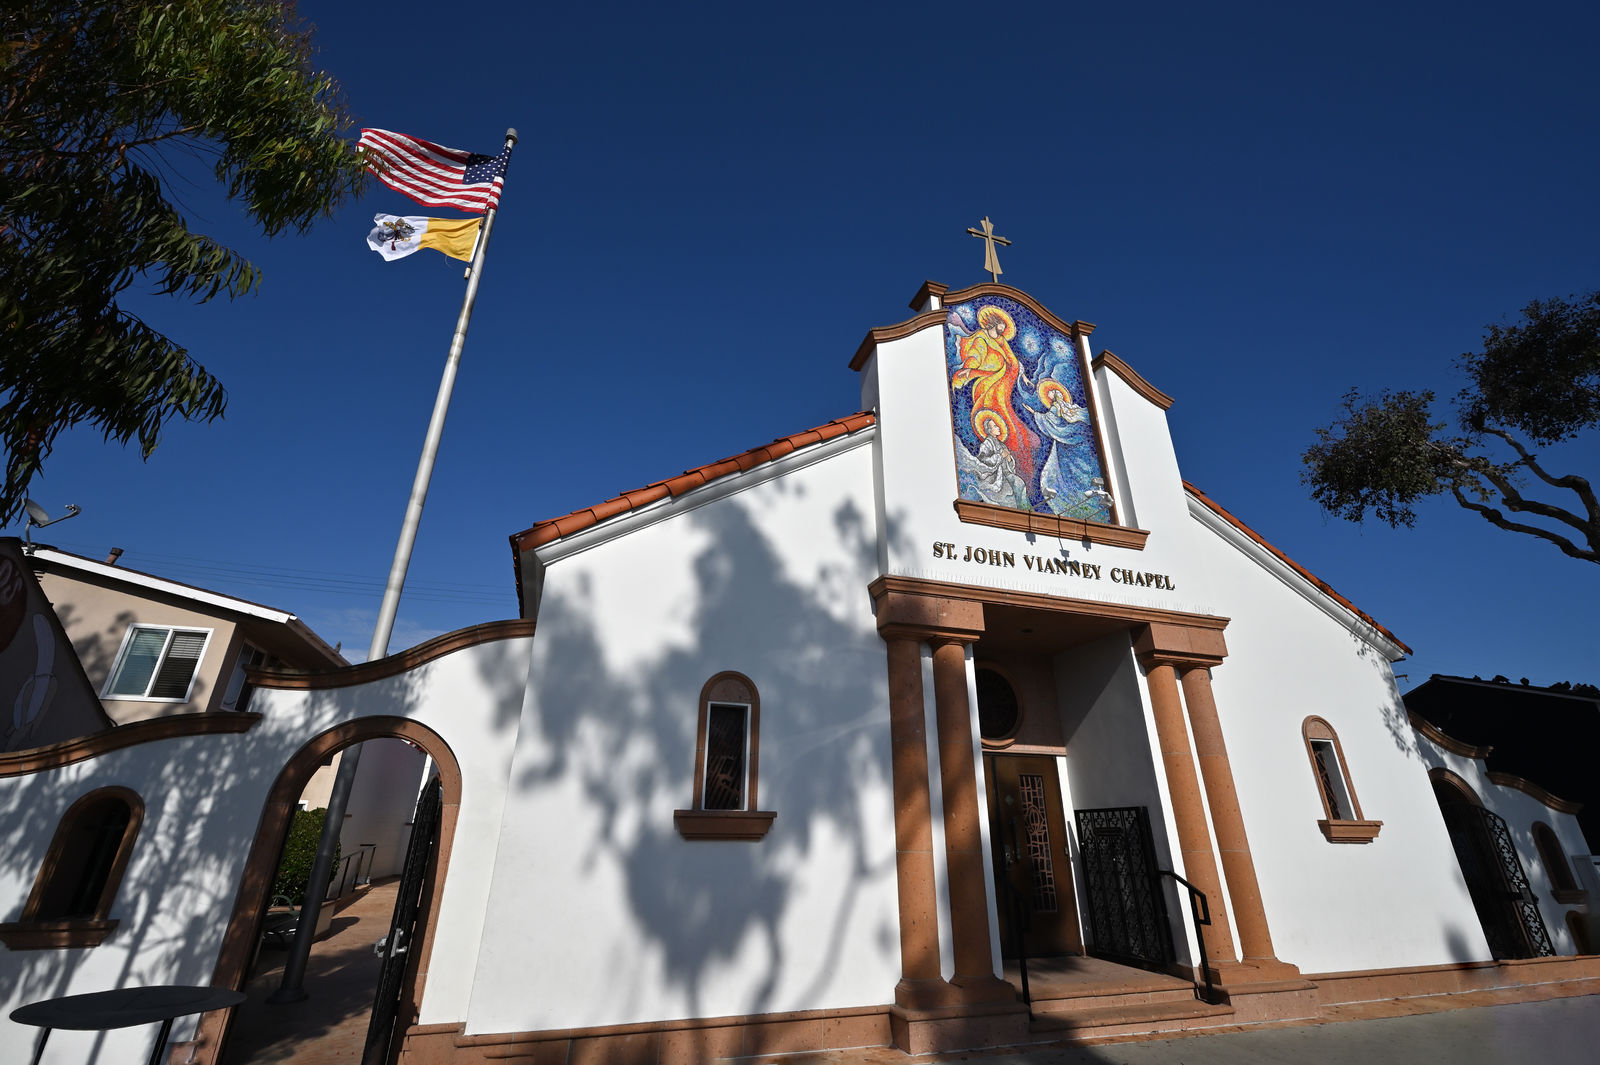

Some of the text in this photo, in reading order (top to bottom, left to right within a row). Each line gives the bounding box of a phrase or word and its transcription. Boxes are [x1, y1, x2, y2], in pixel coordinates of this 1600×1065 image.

[933, 541, 1176, 591] ST. JOHN VIANNEY CHAPEL
